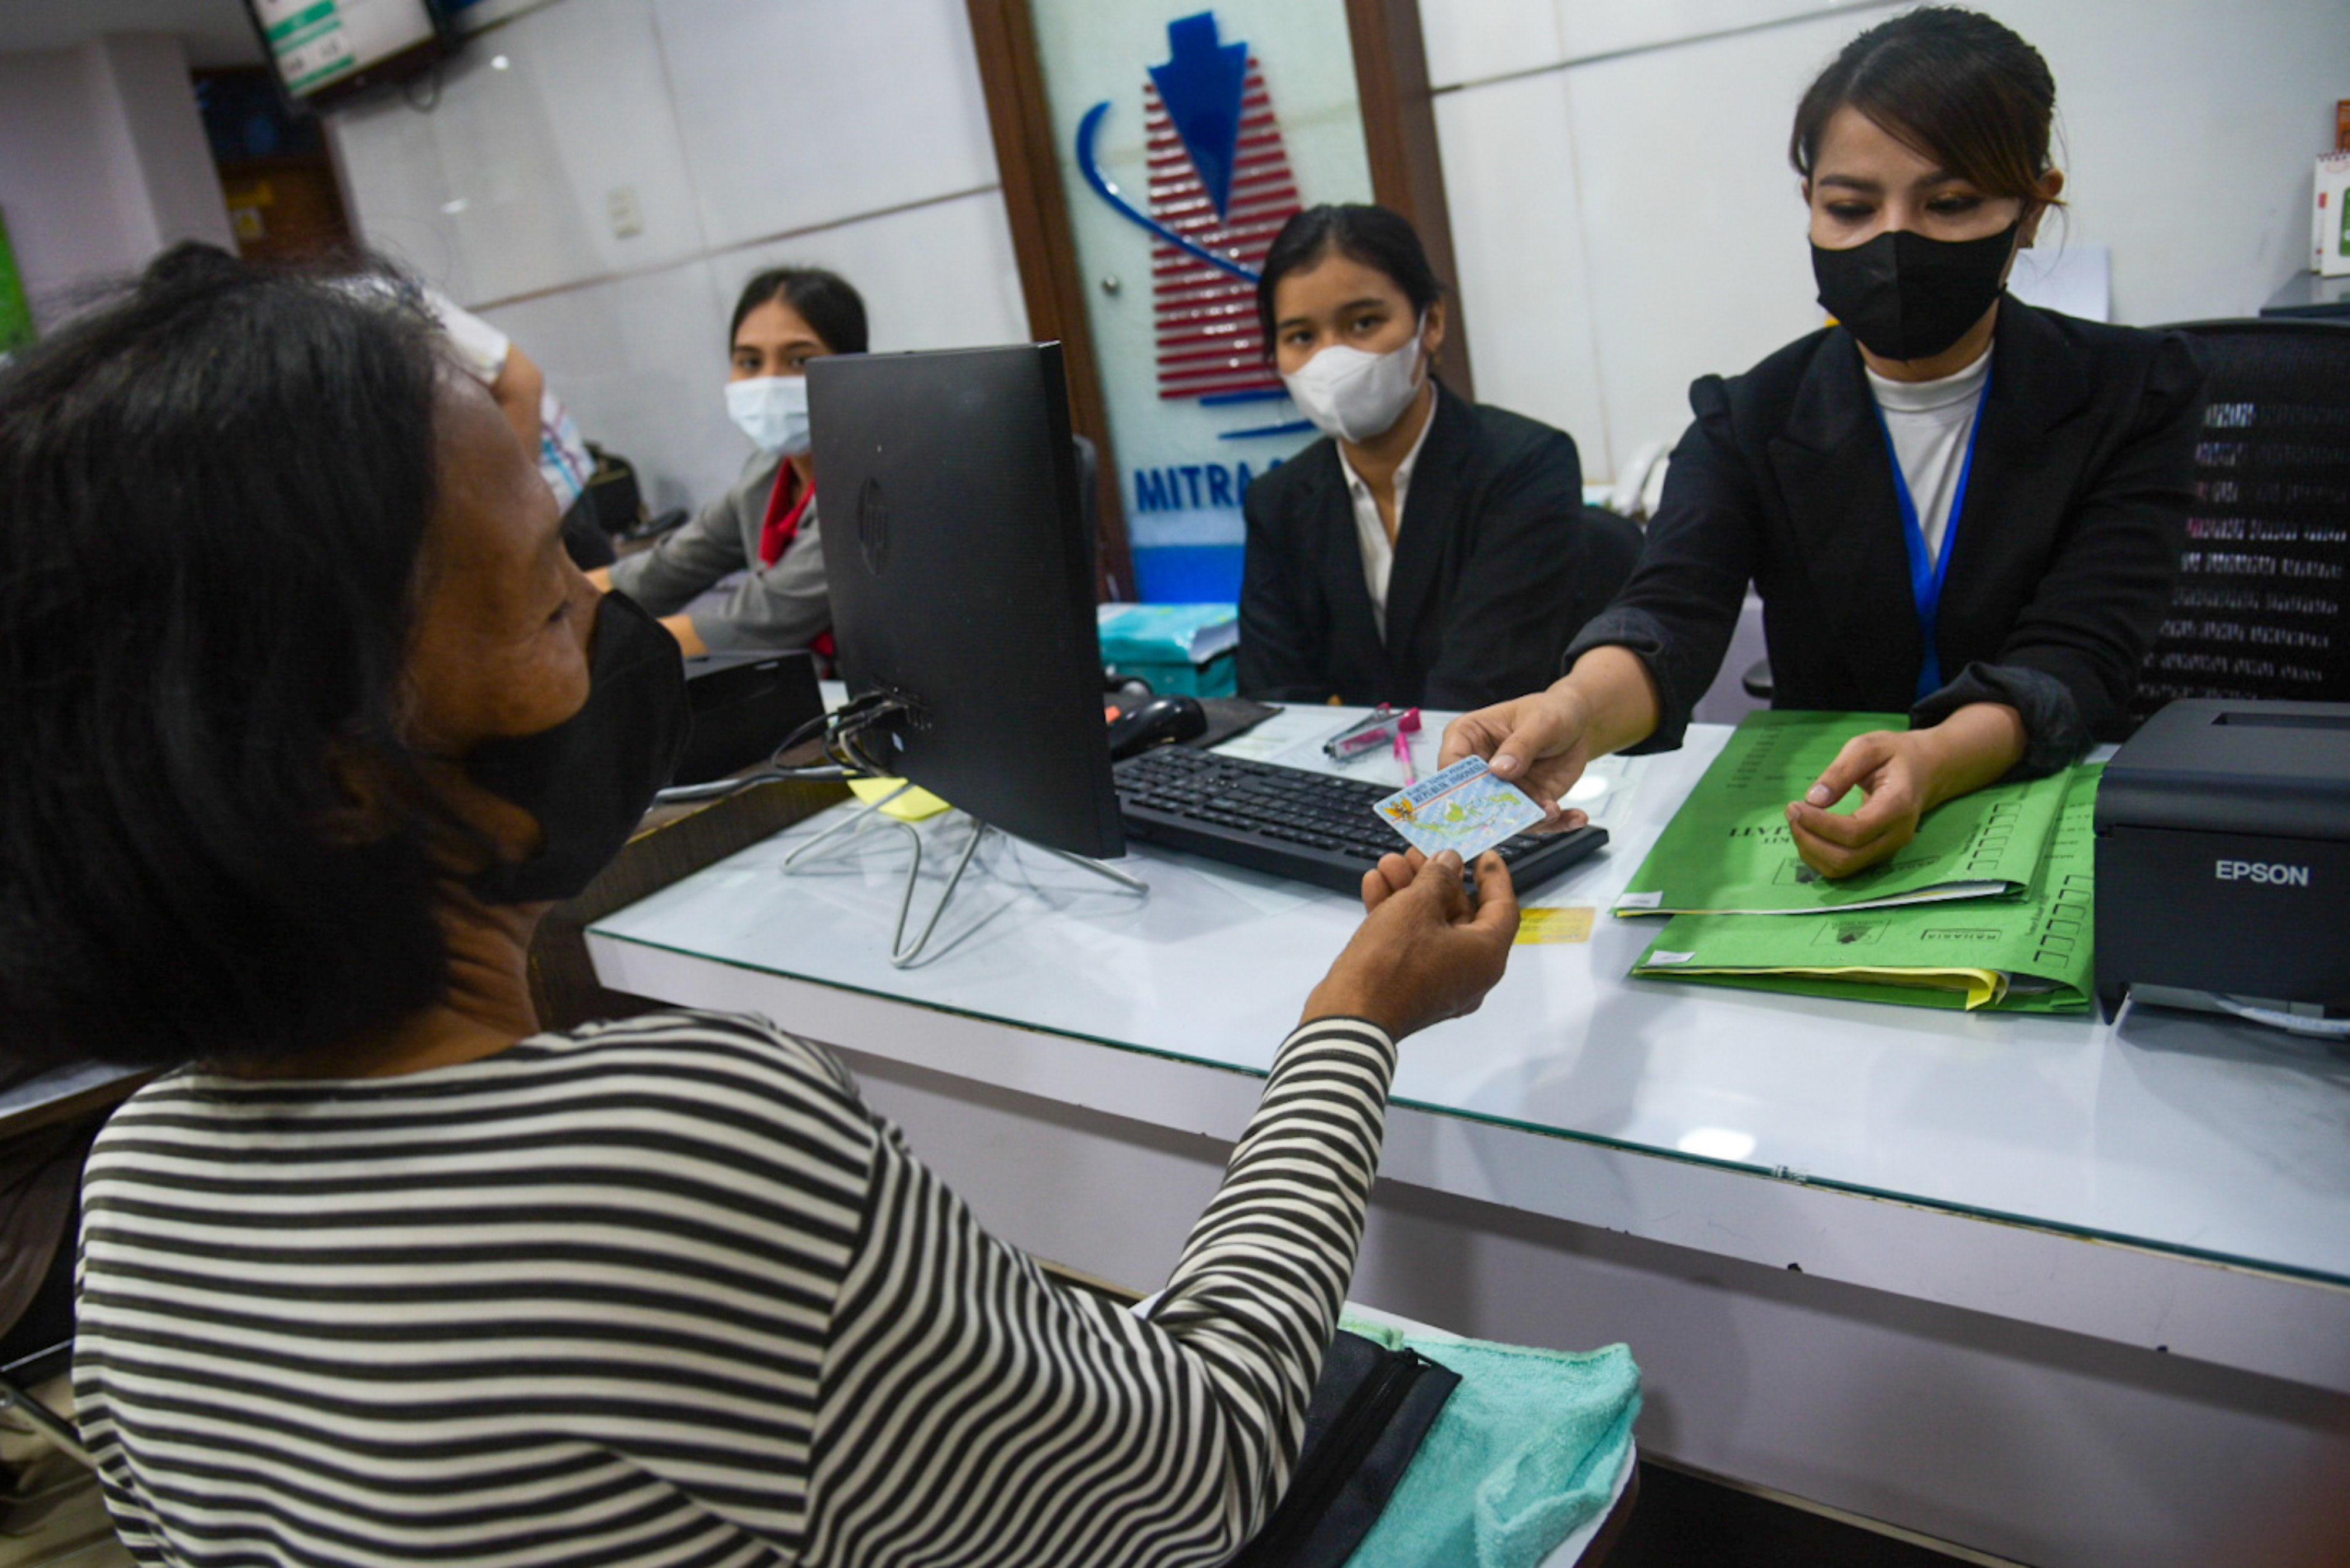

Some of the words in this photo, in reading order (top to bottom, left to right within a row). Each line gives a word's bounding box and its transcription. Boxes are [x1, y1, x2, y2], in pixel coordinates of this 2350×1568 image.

[1134, 461, 1250, 513] MITRA
[1729, 826, 1791, 837] JATI
[2215, 859, 2308, 887] EPSON
